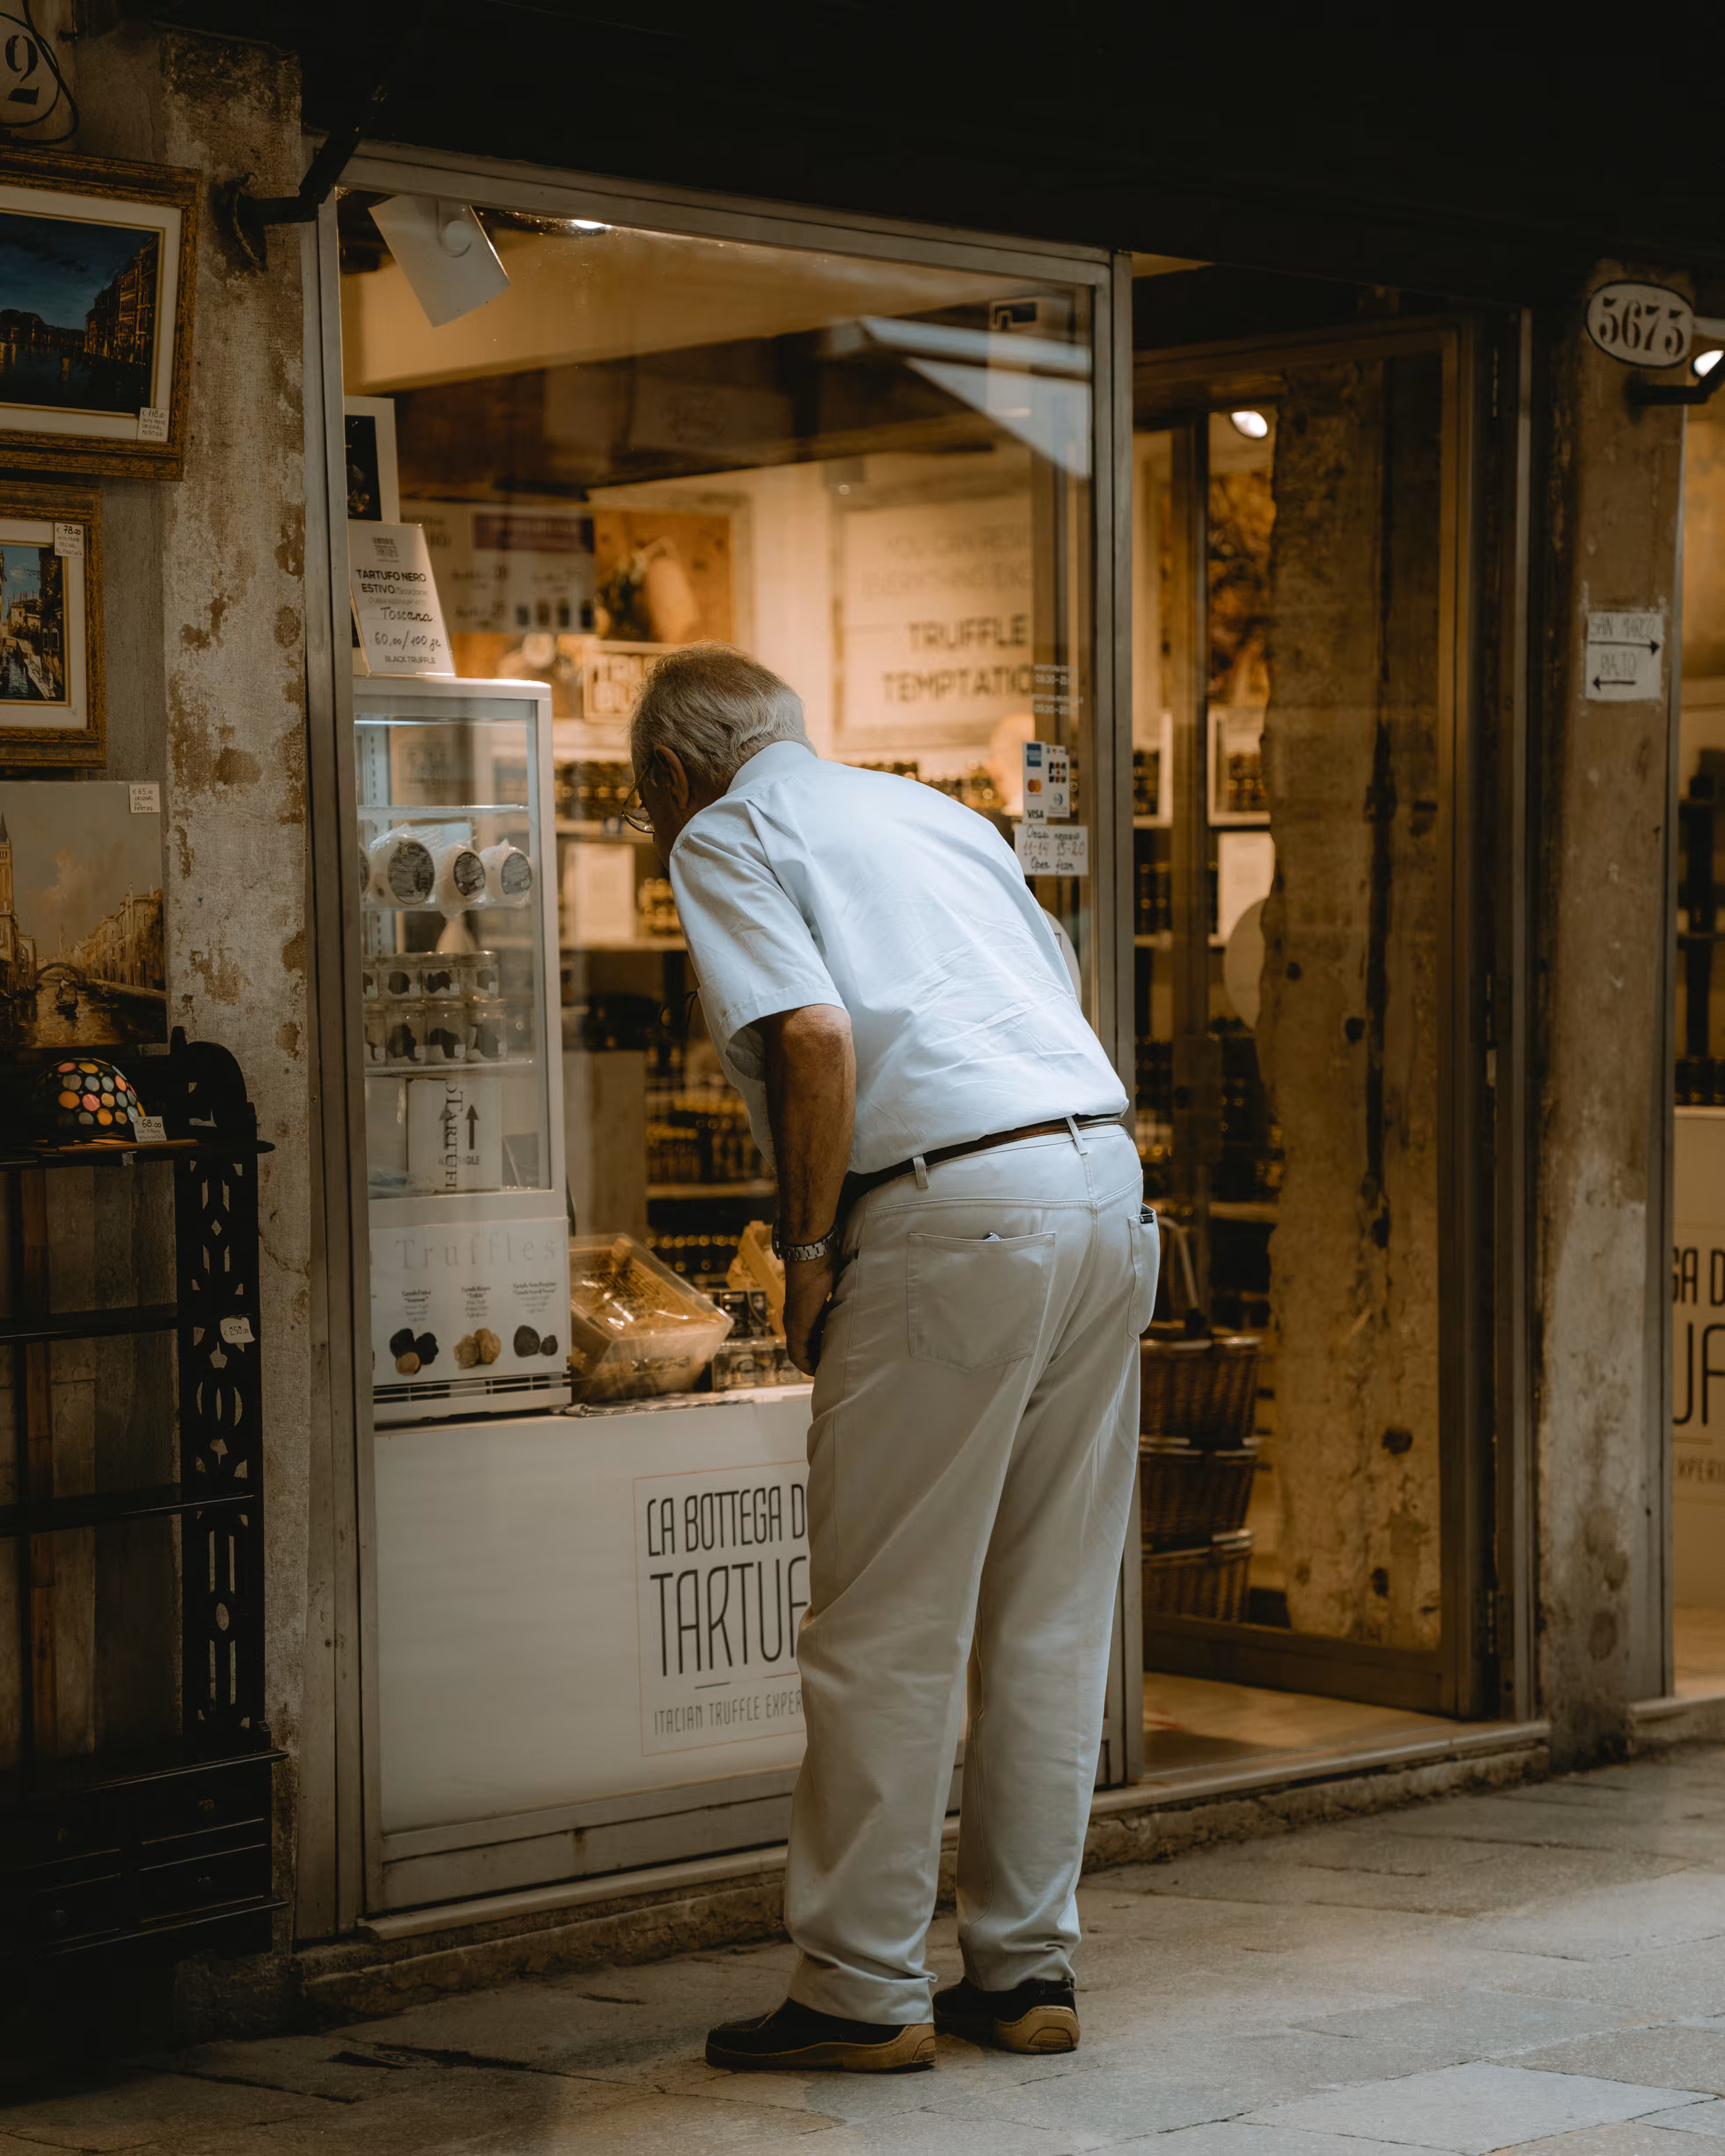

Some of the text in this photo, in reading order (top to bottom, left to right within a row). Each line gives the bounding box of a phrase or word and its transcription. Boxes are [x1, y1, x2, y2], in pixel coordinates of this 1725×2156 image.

[355, 569, 426, 582] TARTUFO NERO
[361, 583, 395, 594] ESTIVO
[908, 613, 1029, 654] TRUFFLE
[1027, 809, 1044, 819] VISA
[395, 1232, 558, 1268] Truffles
[646, 1496, 676, 1558] LA
[683, 1485, 782, 1553] BOTTEGA
[649, 1556, 808, 1678] TARTUF
[654, 1703, 703, 1735] ITALIAN
[709, 1695, 760, 1726] TRUFFLE
